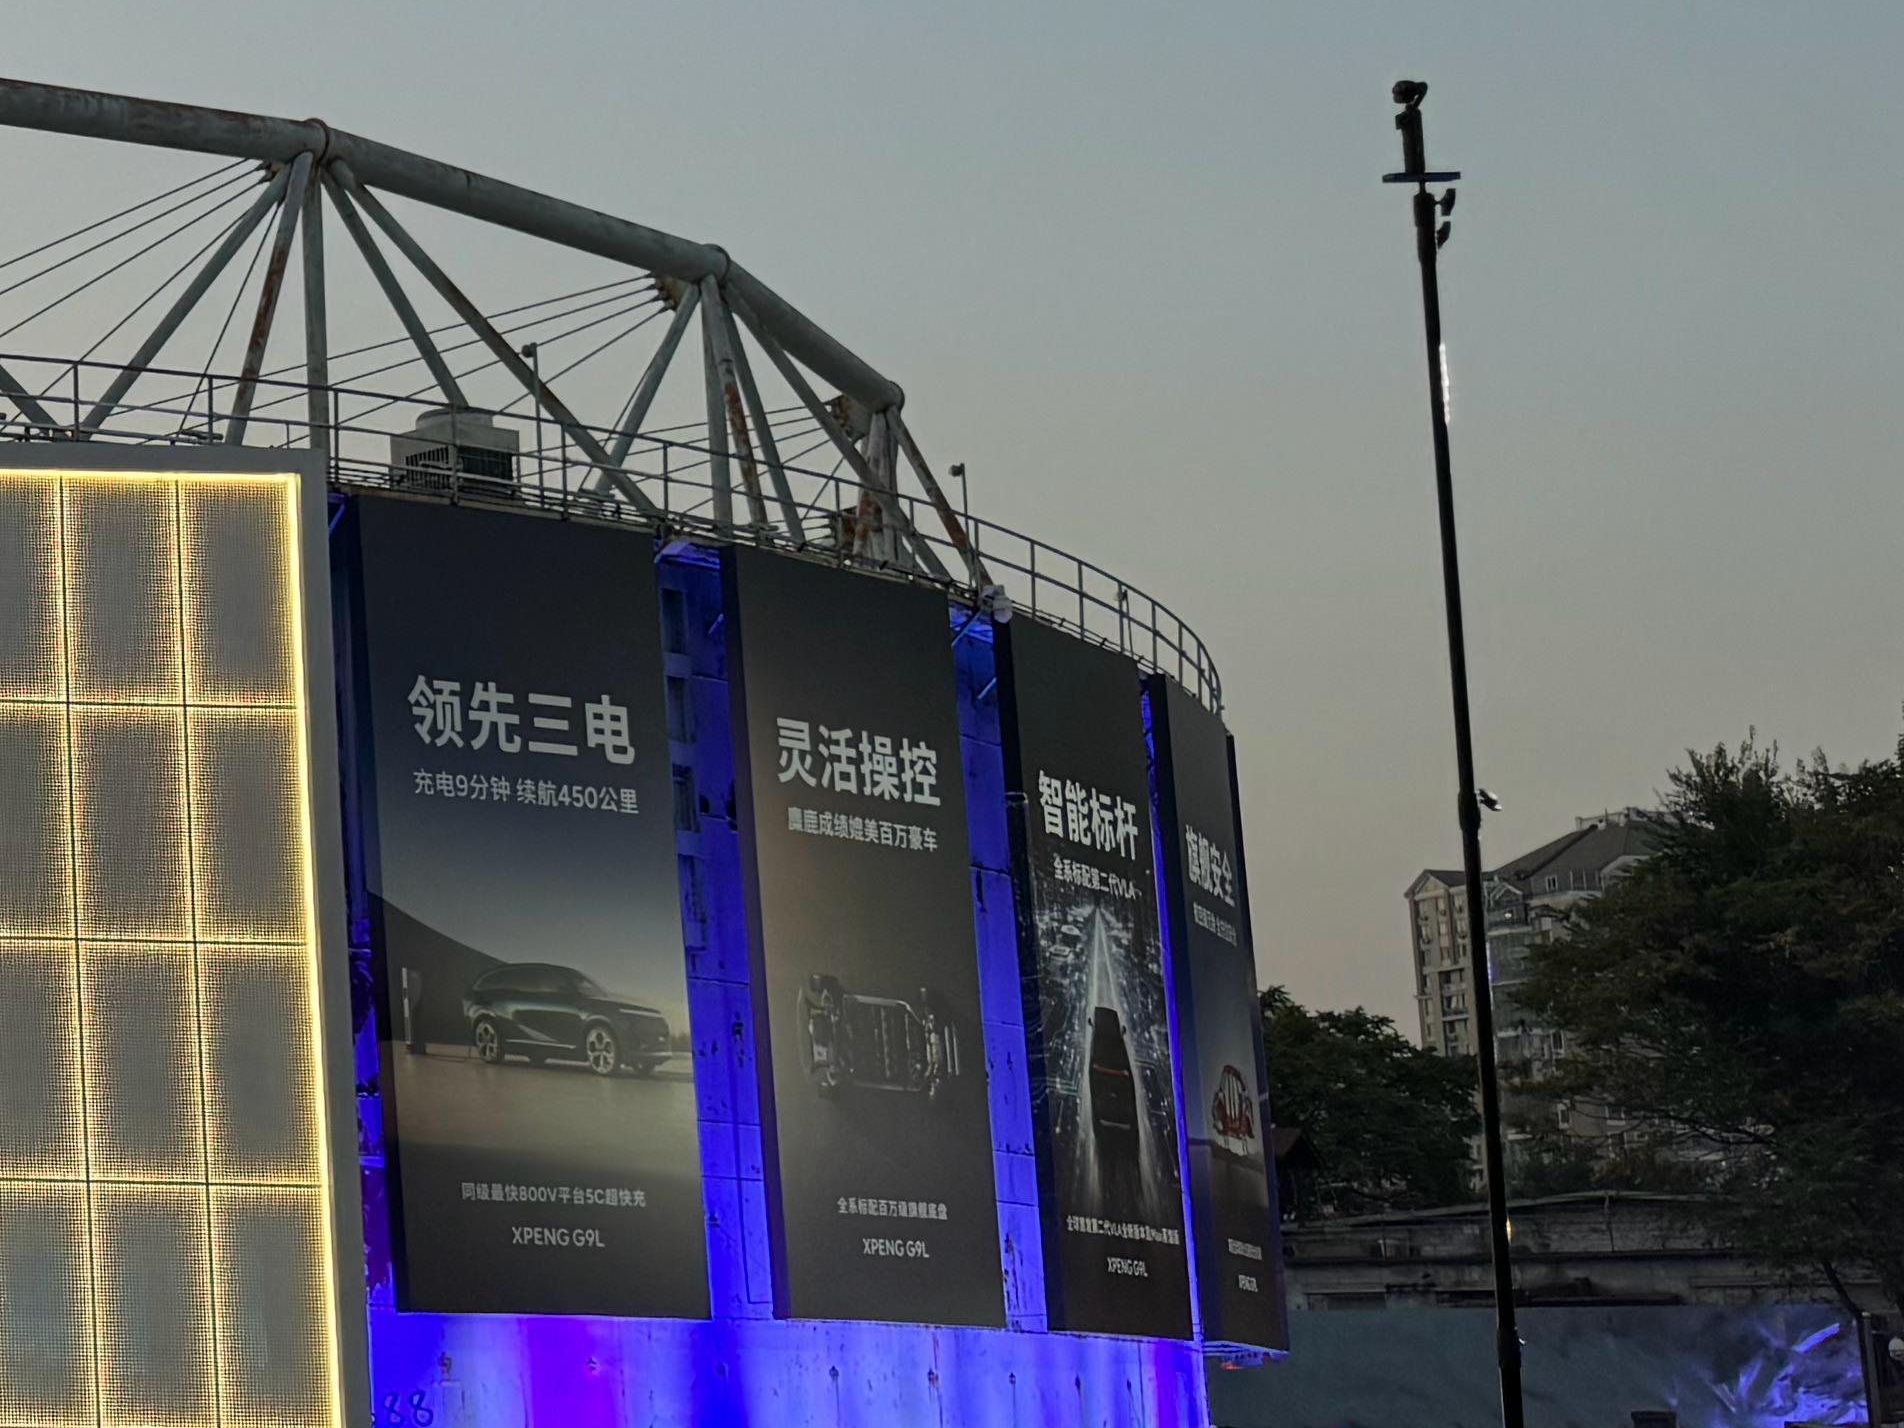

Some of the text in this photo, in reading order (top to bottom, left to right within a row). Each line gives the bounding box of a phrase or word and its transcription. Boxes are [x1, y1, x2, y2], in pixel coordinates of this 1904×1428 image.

[407, 674, 635, 765] 领先三电
[413, 768, 640, 815] 充电9分钟 续航450公里
[776, 717, 941, 807] 灵活操控
[1037, 769, 1138, 861] 智能标杆
[1184, 823, 1235, 907] 旗舰安全
[461, 1182, 646, 1208] 同级最快800V平台5C超快充
[512, 1225, 605, 1248] XPENG G9L
[862, 1237, 930, 1259] XPENG G9L
